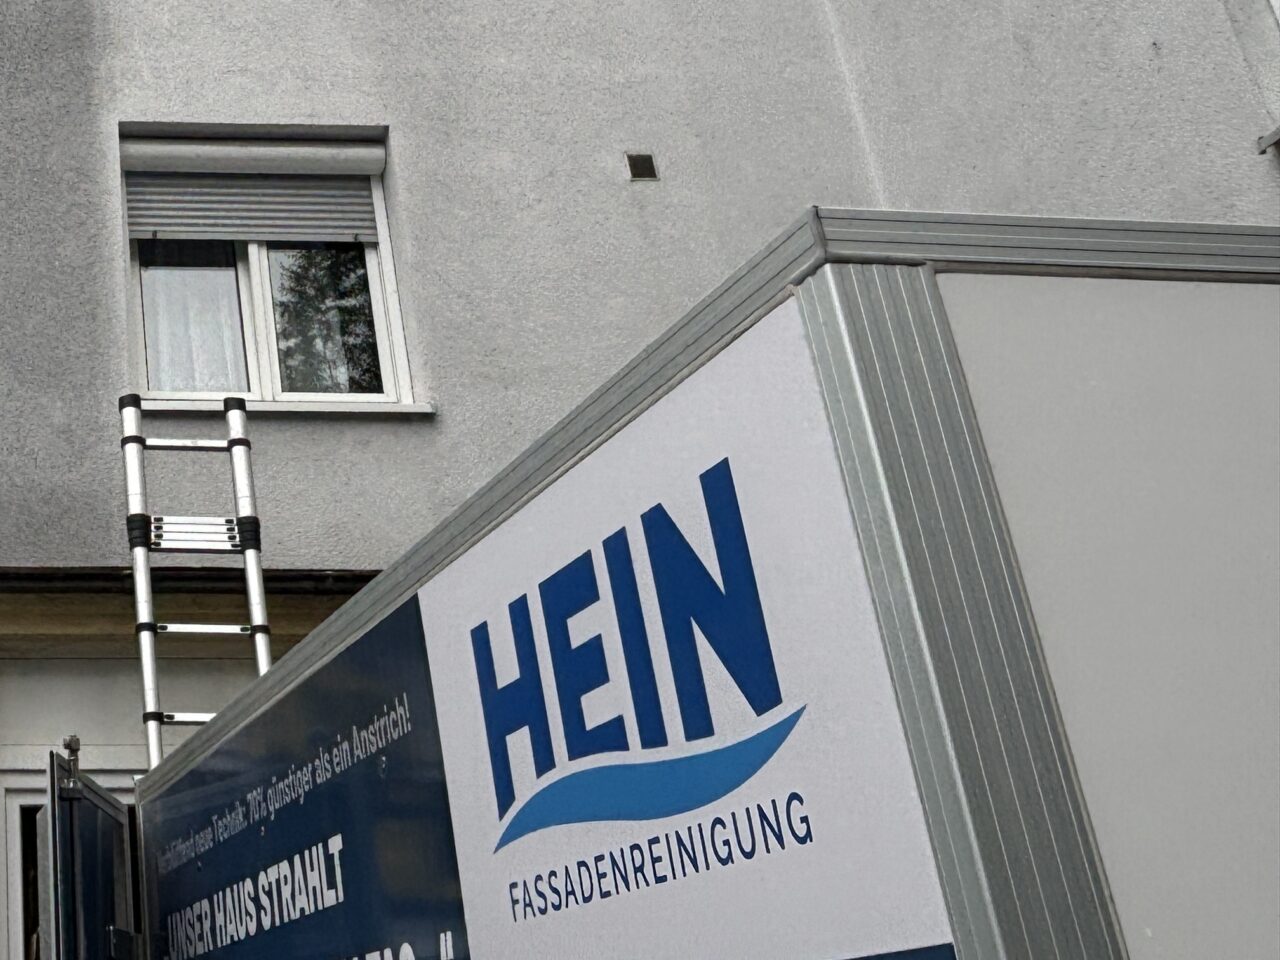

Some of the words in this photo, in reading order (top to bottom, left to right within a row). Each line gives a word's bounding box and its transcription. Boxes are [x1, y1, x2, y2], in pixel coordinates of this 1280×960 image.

[471, 457, 783, 822] HEIN
[247, 786, 267, 824] 70%
[267, 763, 313, 820] günstiger
[314, 747, 332, 784] als
[333, 734, 352, 773] ein
[352, 692, 411, 763] Anstrich!
[213, 878, 257, 948] HAUS
[258, 833, 344, 930] STRAHLT
[509, 792, 814, 922] FASSADENREINIGUNG
